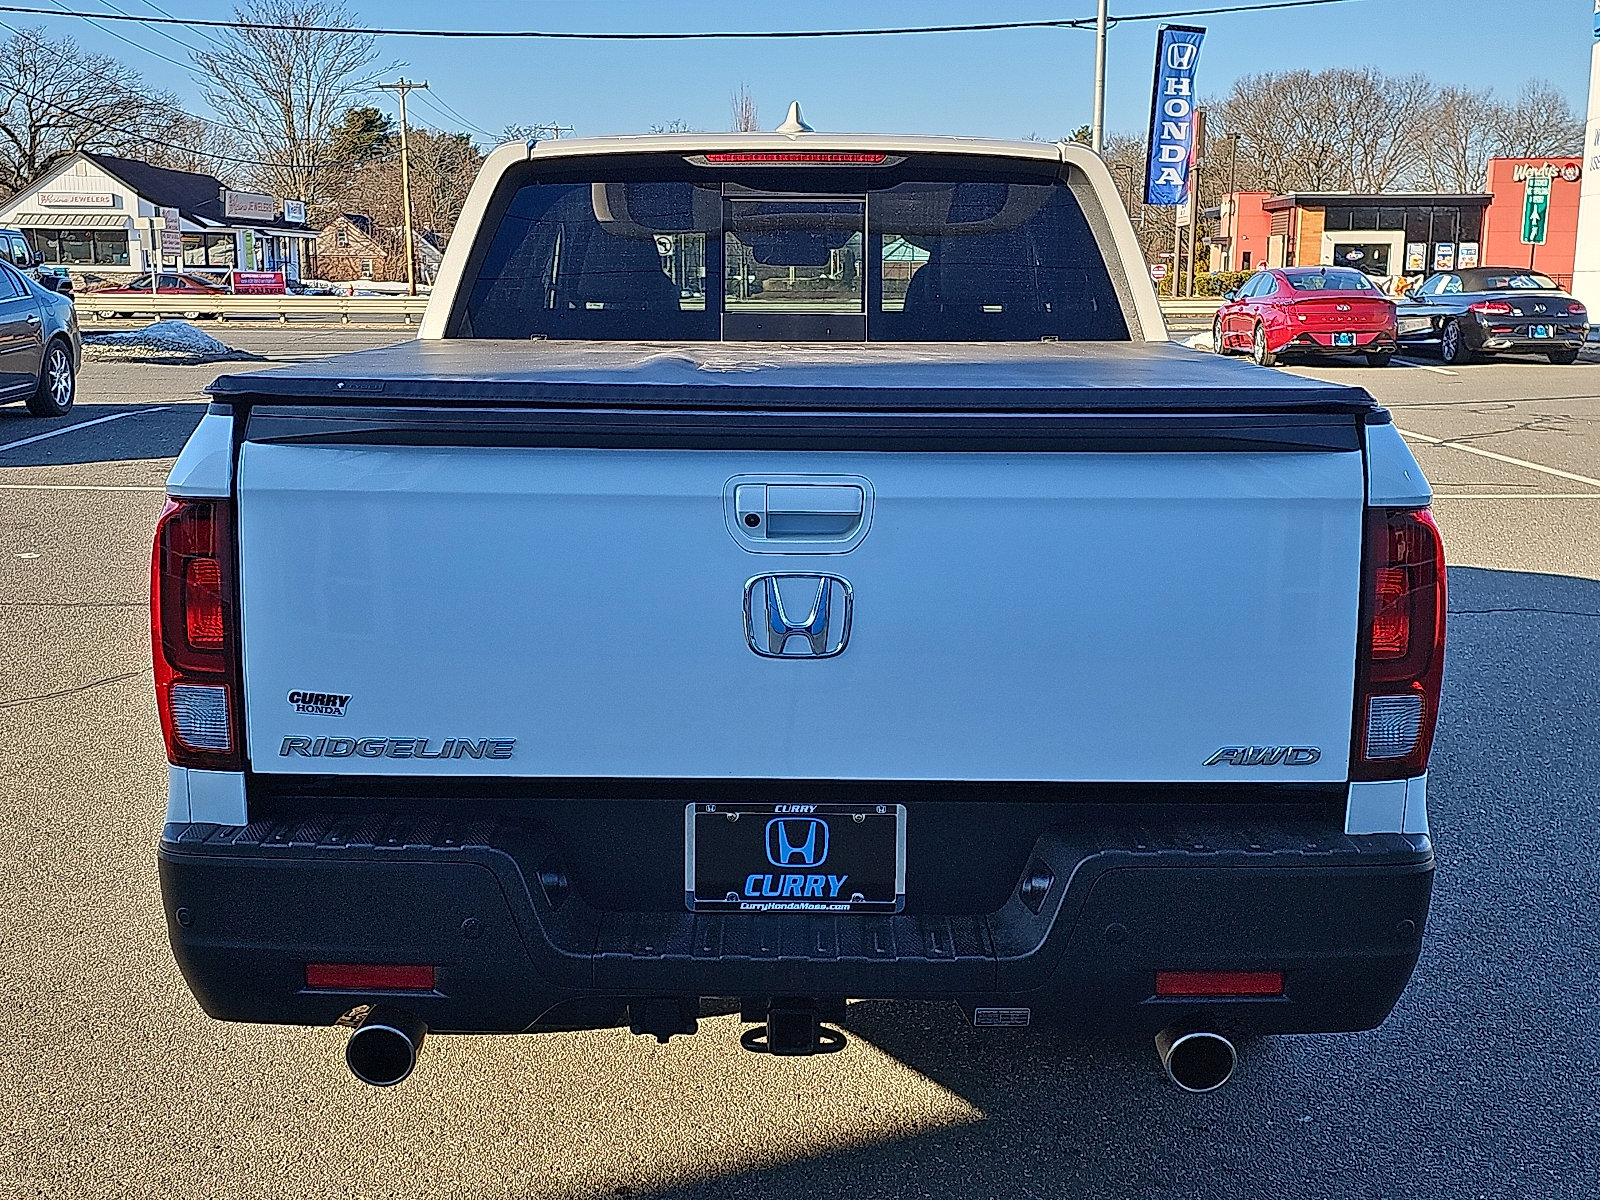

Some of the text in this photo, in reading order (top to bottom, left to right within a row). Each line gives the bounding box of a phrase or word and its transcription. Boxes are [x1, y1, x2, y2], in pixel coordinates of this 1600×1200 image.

[1154, 76, 1192, 186] HONDA
[1513, 161, 1560, 182] Wendy's
[70, 196, 111, 204] JEWELERS
[288, 690, 351, 708] CURRY
[295, 703, 344, 716] HONDA
[279, 735, 517, 760] RIDGELINE
[1202, 745, 1321, 767] AWD
[774, 804, 818, 814] CURRY
[744, 874, 849, 898] CURRY
[740, 902, 851, 911] CurryHondaMass.com
